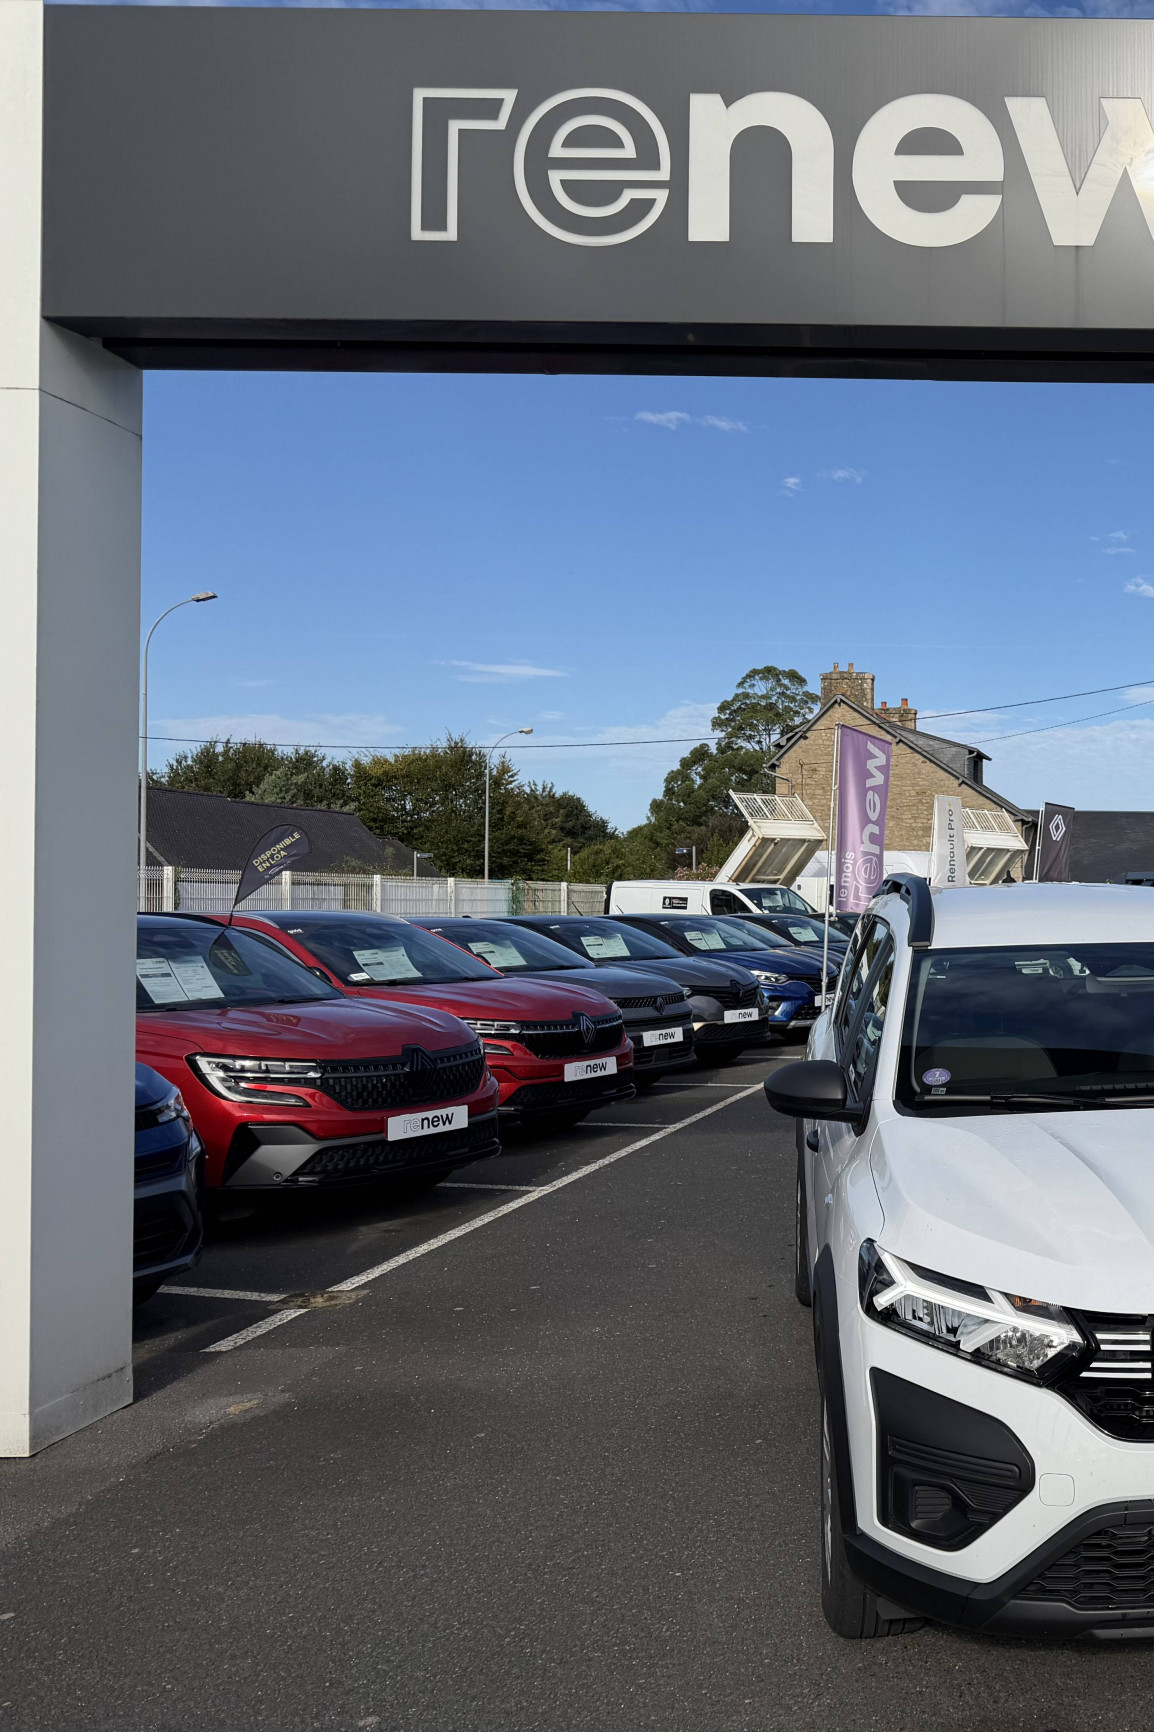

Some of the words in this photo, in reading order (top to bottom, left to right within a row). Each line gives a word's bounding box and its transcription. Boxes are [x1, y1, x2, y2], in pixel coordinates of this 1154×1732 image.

[252, 831, 301, 867] DISPONIBLE
[947, 834, 956, 883] Renault
[256, 861, 271, 872] EN
[268, 850, 288, 865] LOA
[842, 851, 855, 887] mois
[838, 888, 847, 901] le
[574, 1060, 607, 1077] renew
[403, 1112, 454, 1134] renew
